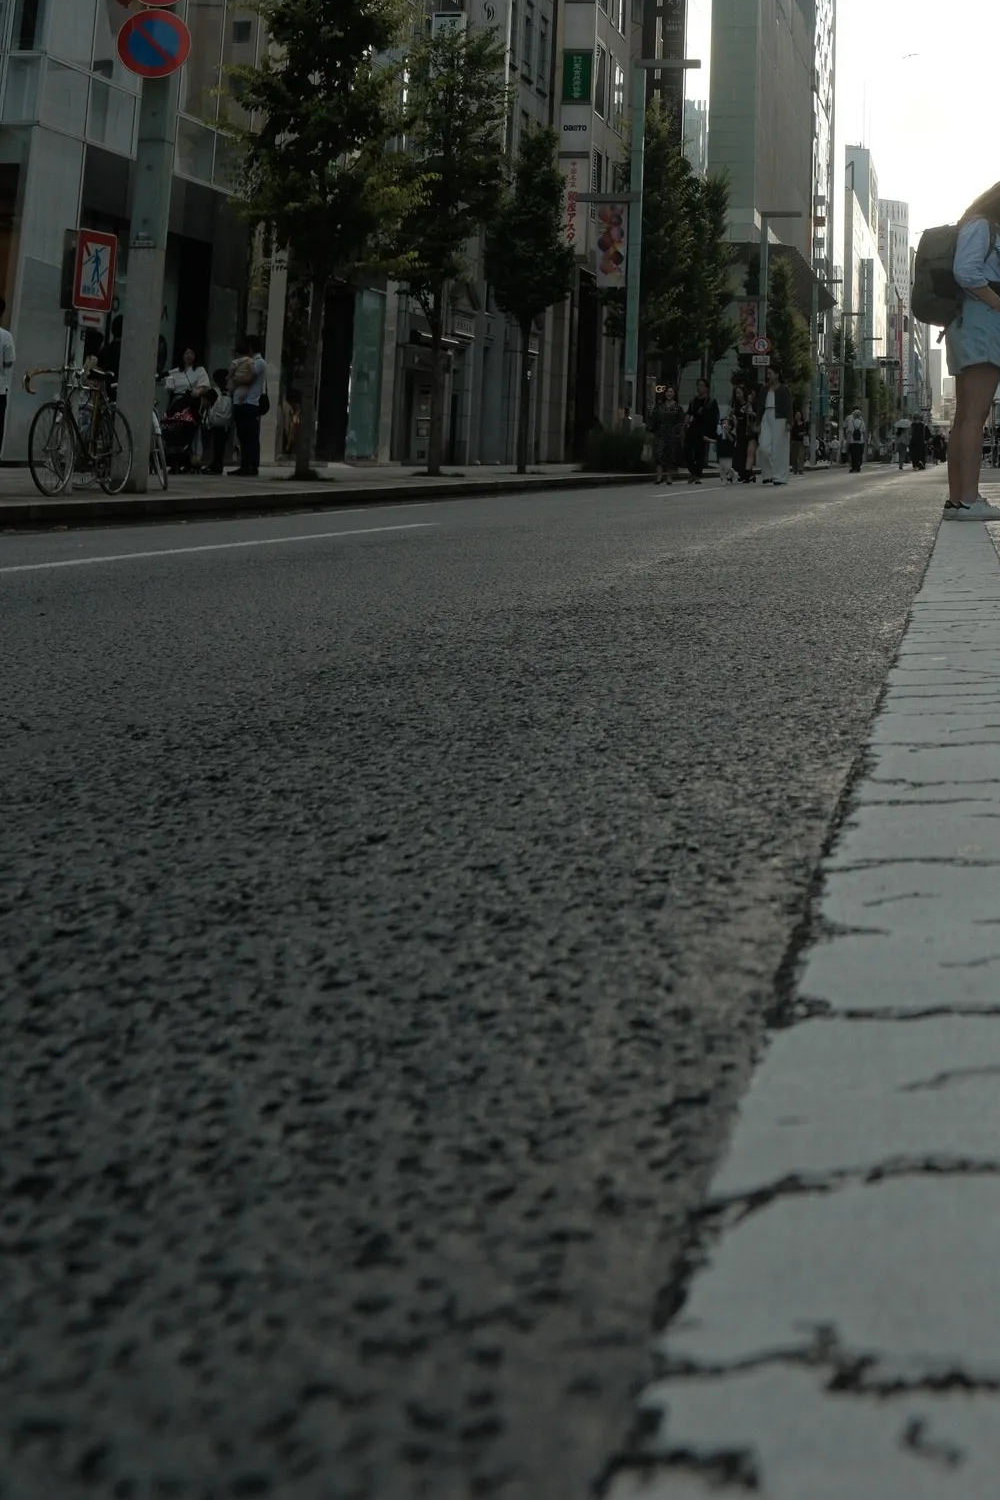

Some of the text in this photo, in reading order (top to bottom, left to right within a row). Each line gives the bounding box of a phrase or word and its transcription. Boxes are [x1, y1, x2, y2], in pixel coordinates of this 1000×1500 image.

[566, 191, 578, 243] 銀座アスタ
